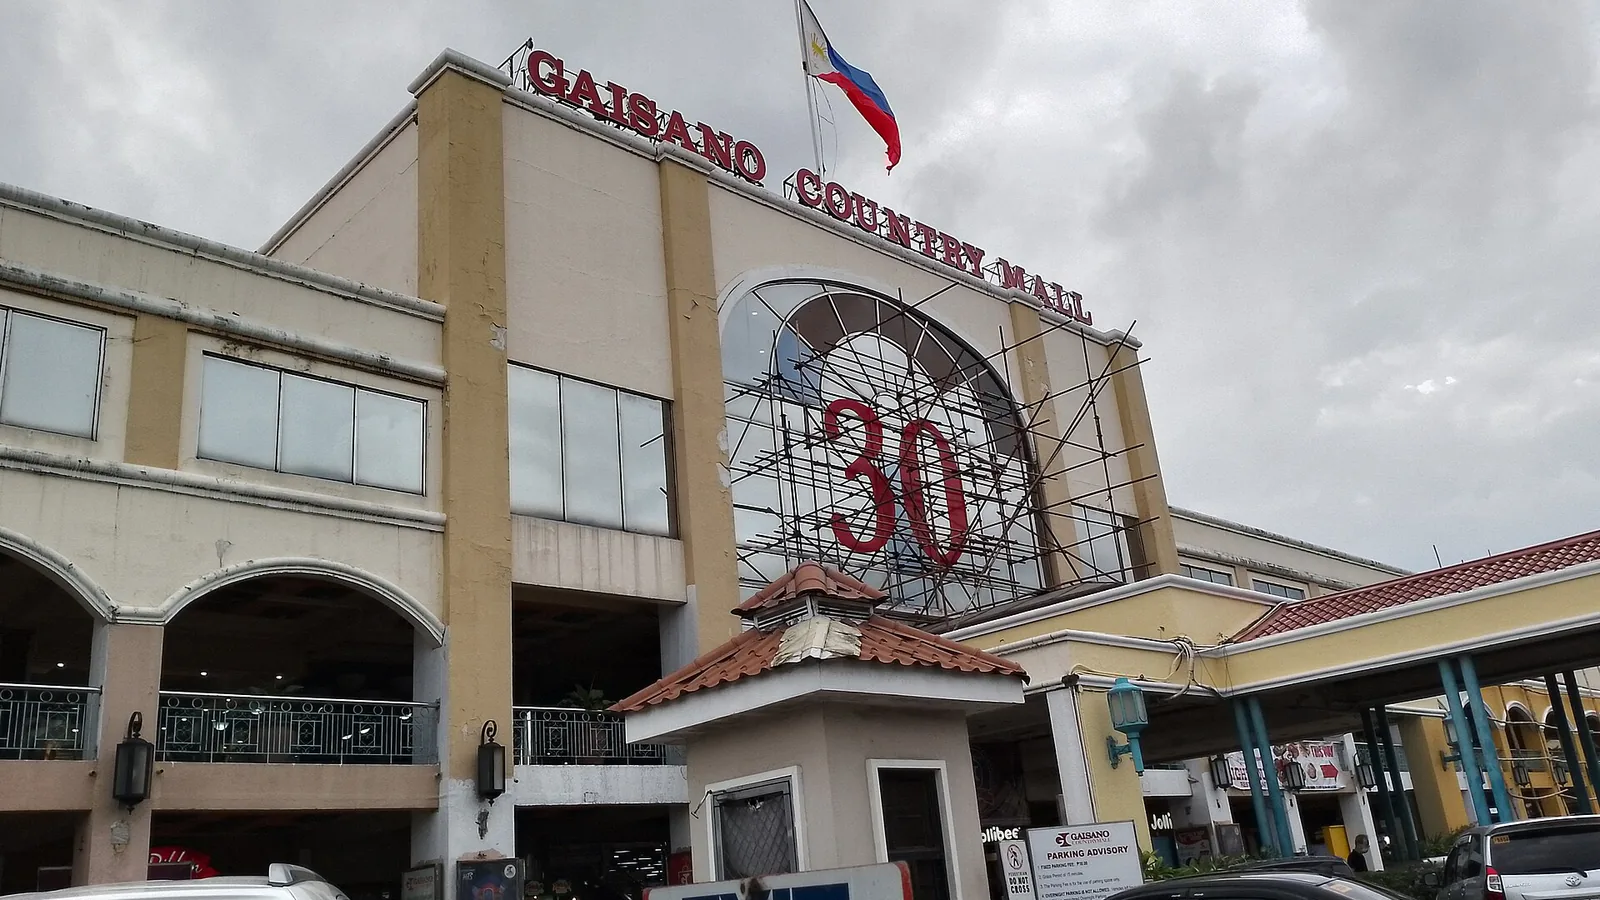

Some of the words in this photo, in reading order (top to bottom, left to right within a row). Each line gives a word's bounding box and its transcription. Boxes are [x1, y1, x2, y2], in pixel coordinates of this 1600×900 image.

[528, 50, 767, 181] GAISANO
[796, 168, 986, 279] COUNTRY
[998, 257, 1093, 326] MALL
[825, 398, 968, 566] 30
[1151, 812, 1173, 830] Jolli
[981, 826, 1019, 843] ollibee
[1071, 830, 1110, 841] GAISANO
[1047, 849, 1085, 861] PARKING
[1087, 845, 1129, 858] ADVISORY
[1009, 877, 1017, 885] DO
[1018, 876, 1029, 885] NOT
[1010, 885, 1030, 894] CROSS
